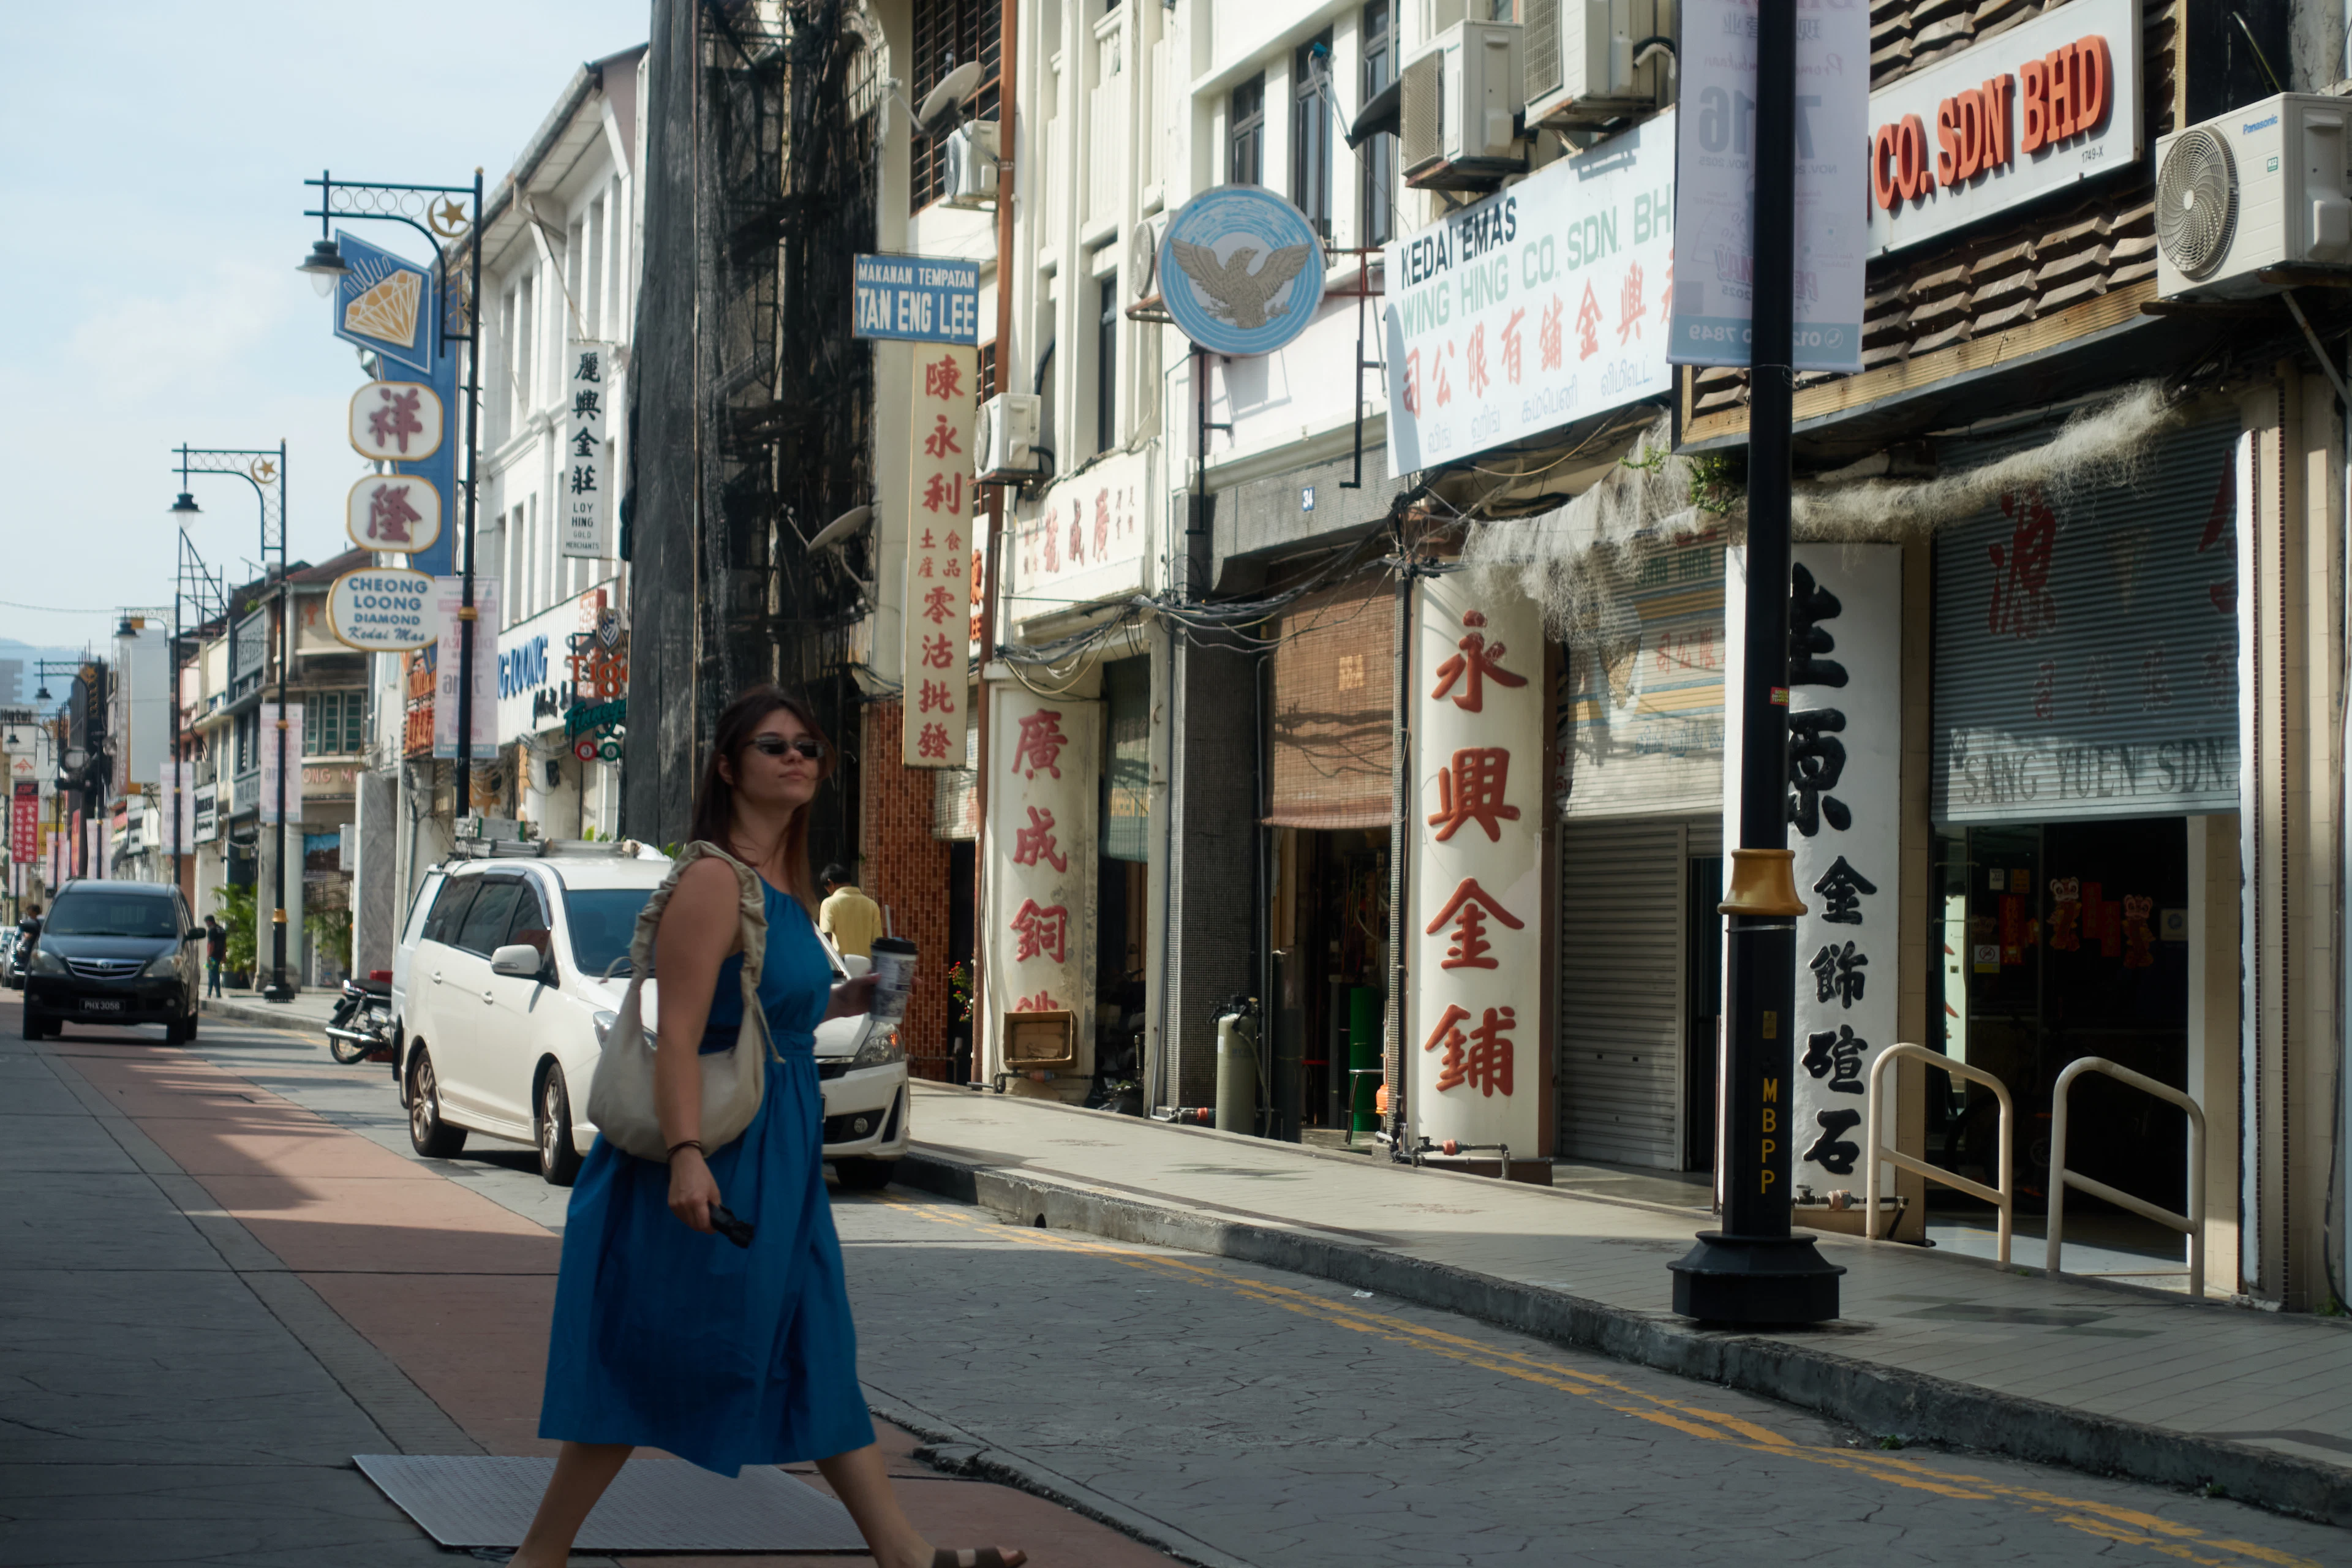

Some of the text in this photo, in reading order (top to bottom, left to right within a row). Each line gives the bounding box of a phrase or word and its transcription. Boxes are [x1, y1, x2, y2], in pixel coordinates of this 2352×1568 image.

[1874, 34, 2113, 210] CO. SDN BHD
[2243, 114, 2278, 135] Panasonic
[2081, 145, 2104, 163] 1749-X
[1401, 196, 1517, 290] KEDAI EMAS
[1401, 280, 1450, 340] WING
[1461, 254, 1509, 317] HING
[1567, 206, 1622, 271] SDN.
[1634, 183, 1672, 246] BH
[858, 263, 974, 288] MAKANAN TEMPATAN
[858, 288, 974, 336] TAN ENG LEE
[922, 353, 965, 514] 陳永利
[573, 502, 594, 514] LOY
[1303, 488, 1313, 508] 34
[571, 516, 594, 527] HING
[573, 530, 592, 539] GOLD
[566, 540, 600, 550] MERCHANTS
[348, 577, 428, 594] CHEONG
[353, 595, 422, 611] LOONG
[354, 613, 420, 626] DIAMOND
[348, 626, 426, 643] Kedai Mas
[918, 586, 957, 760] 零沽批發
[584, 747, 590, 756] 3
[608, 747, 613, 756] 6
[1963, 752, 2037, 804] SANG
[2056, 742, 2138, 800] YUEN
[1009, 708, 1068, 1012] 廣成銅
[1425, 609, 1529, 1098] 永興金鋪
[1760, 1078, 1777, 1194] MBPP
